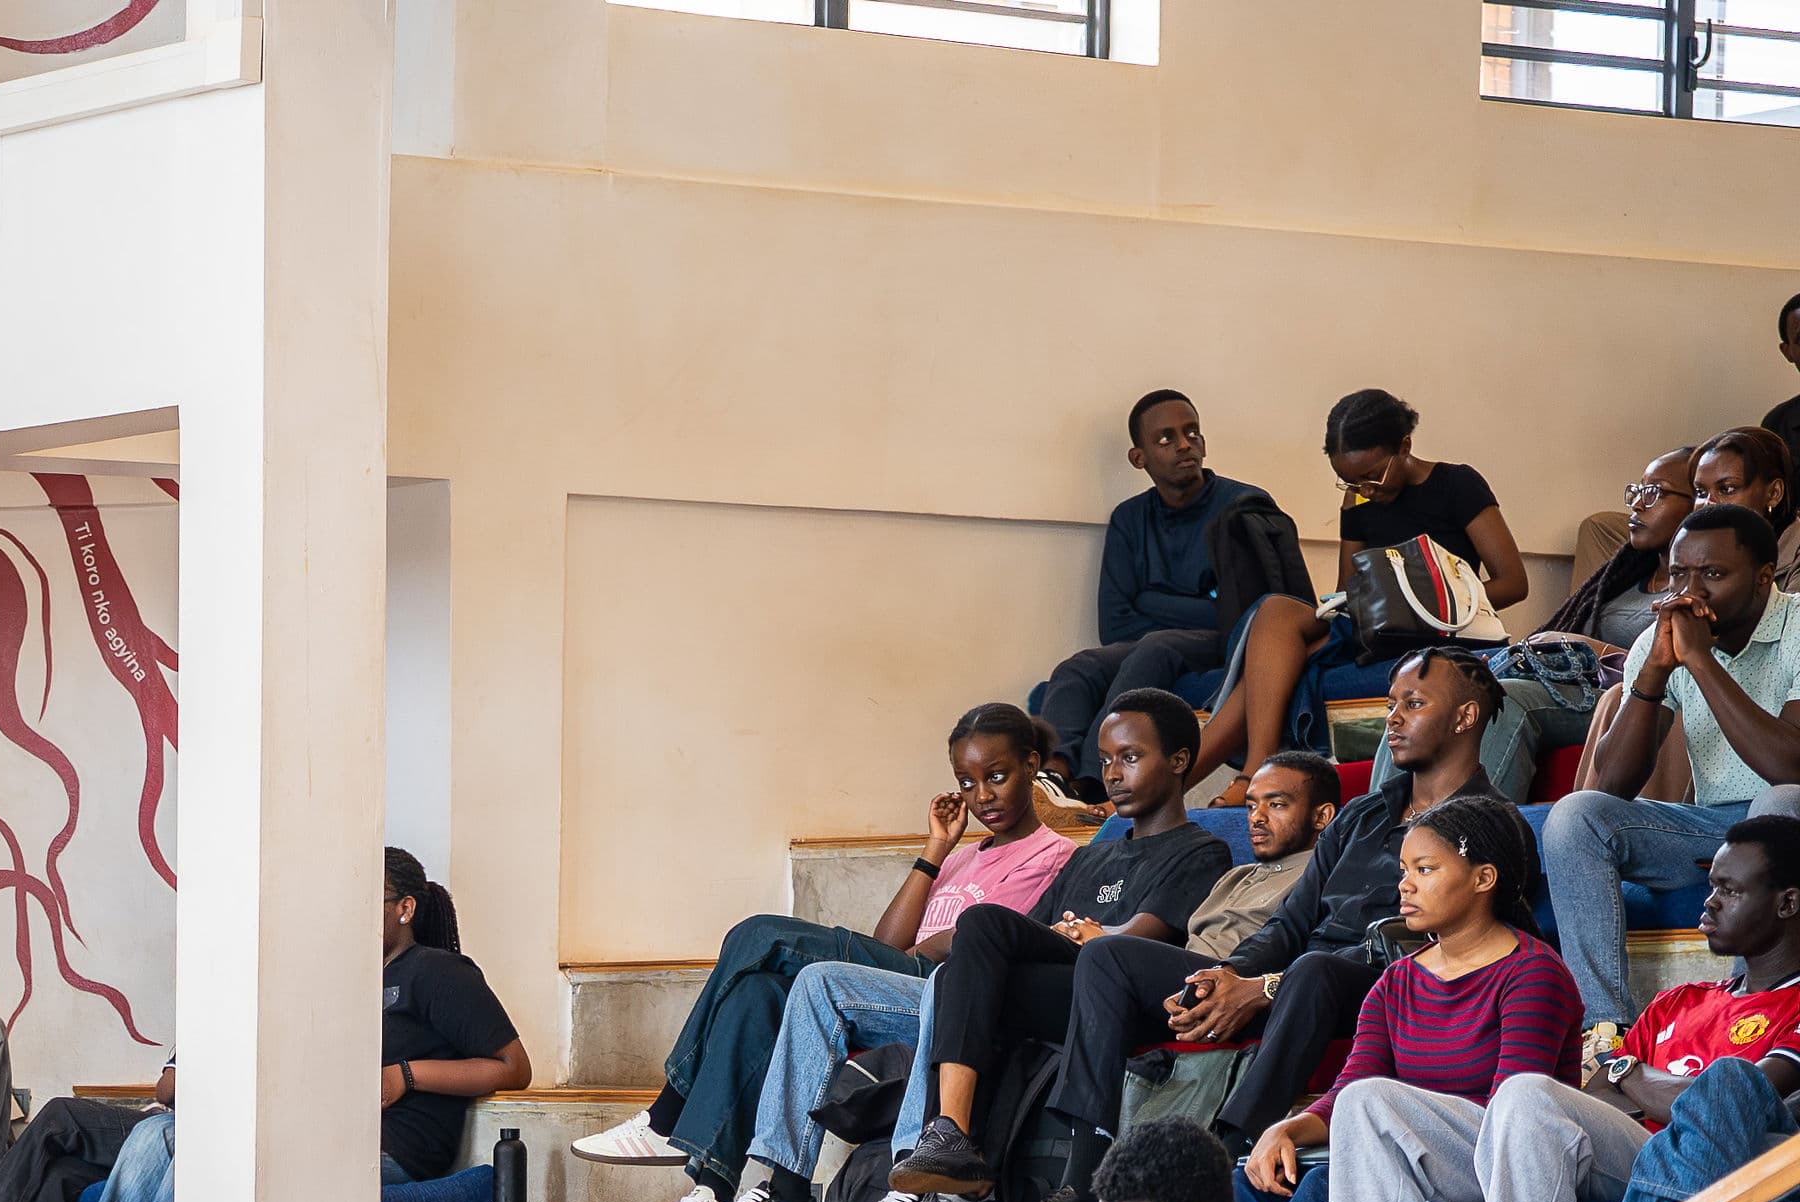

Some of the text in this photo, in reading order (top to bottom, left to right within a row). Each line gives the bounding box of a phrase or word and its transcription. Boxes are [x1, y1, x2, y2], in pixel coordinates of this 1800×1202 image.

[75, 521, 146, 683] Ti koro nko agyina
